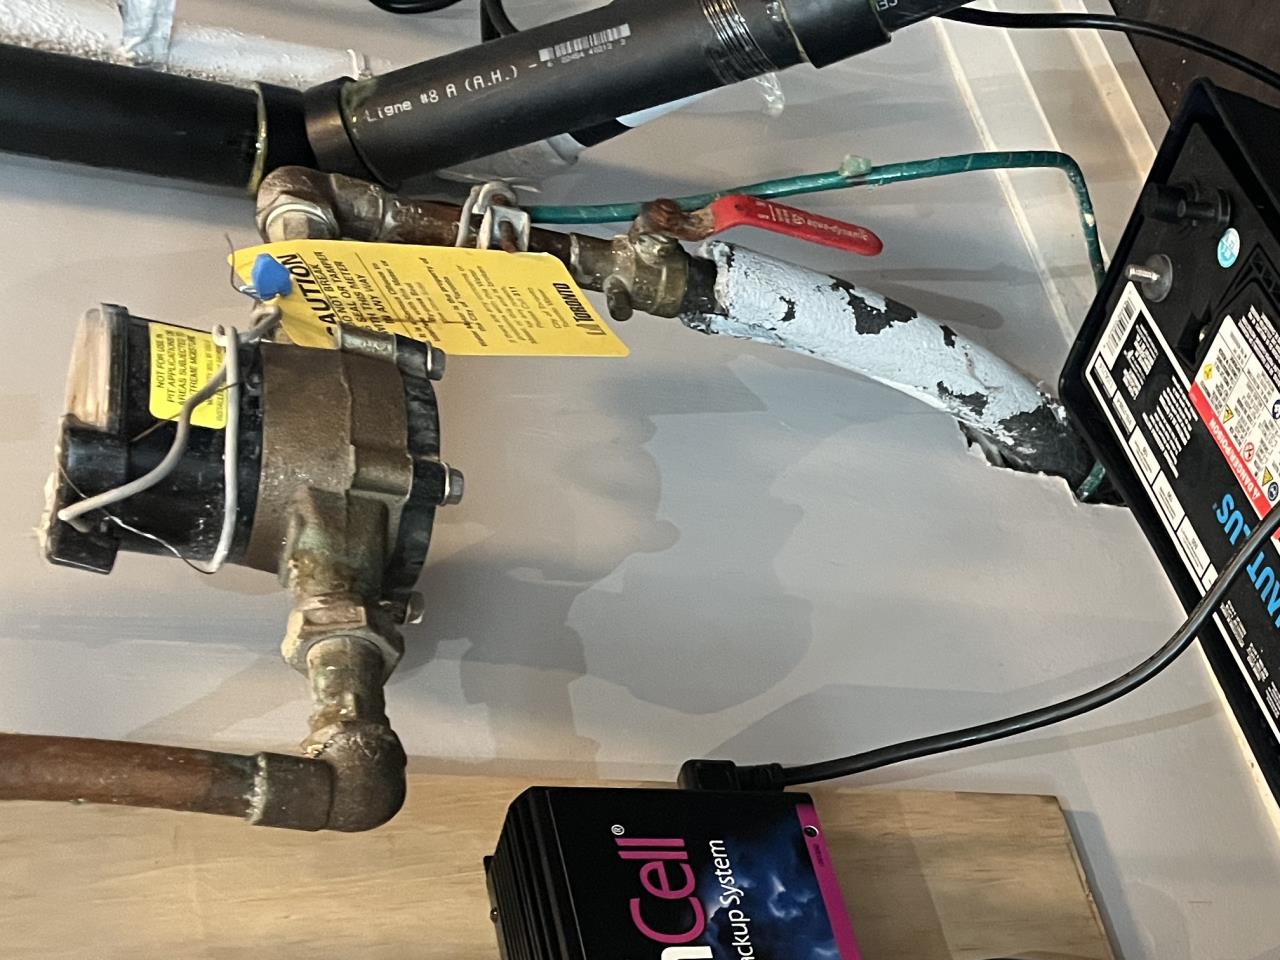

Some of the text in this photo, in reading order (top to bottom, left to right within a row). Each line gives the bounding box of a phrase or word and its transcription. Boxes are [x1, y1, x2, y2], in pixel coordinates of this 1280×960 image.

[365, 101, 412, 122] Ligne
[420, 90, 439, 104] #8
[446, 84, 457, 98] A
[465, 65, 517, 92] (A.H.)
[309, 264, 334, 292] BREAK
[314, 252, 367, 322] SEAL OR TAMPER
[334, 261, 360, 289] METER
[355, 274, 374, 292] WAY
[277, 254, 337, 335] AUTION
[328, 295, 347, 313] NOT
[354, 292, 373, 310] THIS
[370, 295, 387, 313] ANY
[709, 840, 743, 908] System
